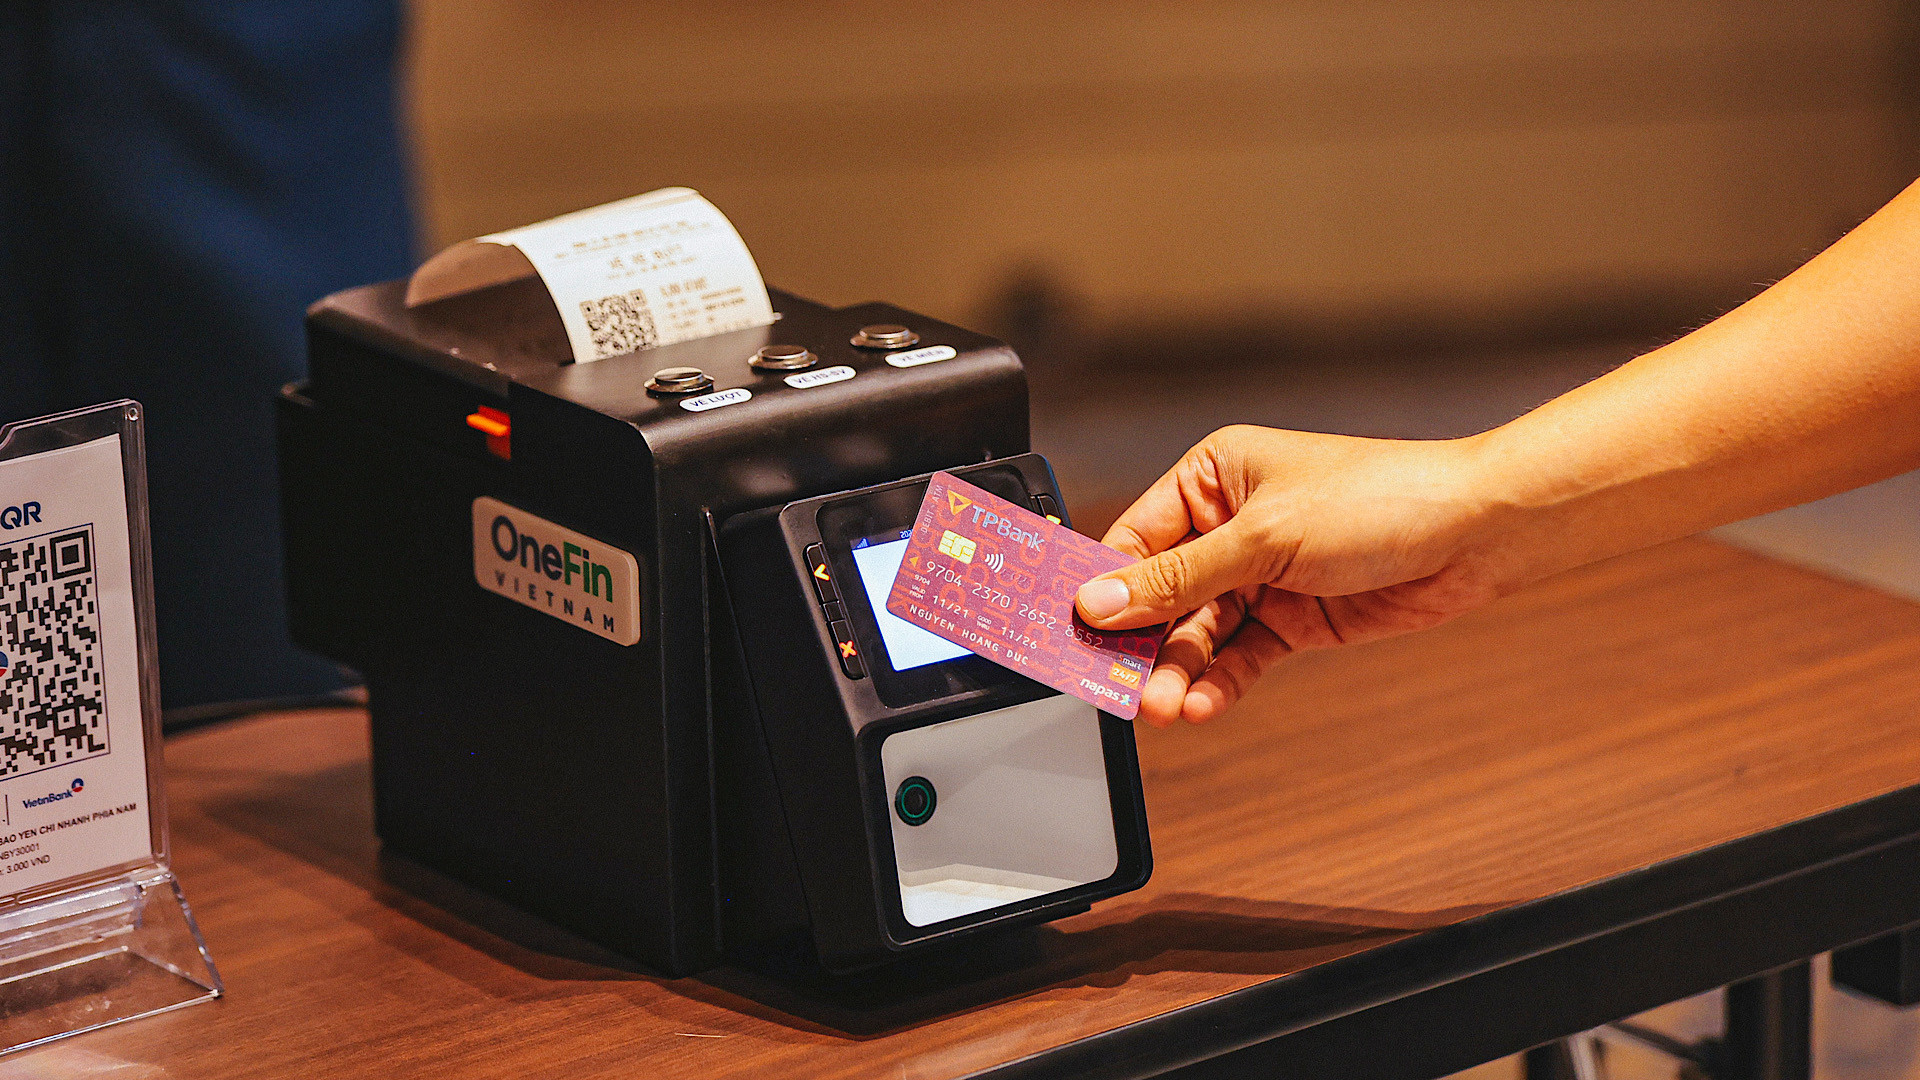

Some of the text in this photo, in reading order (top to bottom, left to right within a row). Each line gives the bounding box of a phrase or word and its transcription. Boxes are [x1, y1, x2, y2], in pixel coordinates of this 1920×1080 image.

[920, 509, 935, 534] DEBIT
[932, 485, 944, 504] ATM
[972, 505, 1045, 552] TPBank
[491, 515, 613, 603] OneFin
[495, 569, 614, 633] VIETNAM
[926, 561, 1103, 650] 9704 2370 2652 8552
[932, 595, 969, 619] 11/21
[909, 604, 1029, 666] NGUYEN HOANG DUC
[1001, 626, 1038, 650] 11/26
[1112, 667, 1138, 685] 24/7
[1118, 654, 1142, 670] Smart
[1079, 677, 1120, 702] napas
[18, 828, 38, 840] YEN
[39, 823, 56, 835] CHI
[57, 815, 91, 830] NHANH
[92, 809, 115, 820] PHIA
[116, 802, 137, 815] NAM
[6, 860, 29, 874] 3.000
[30, 854, 51, 867] VND
